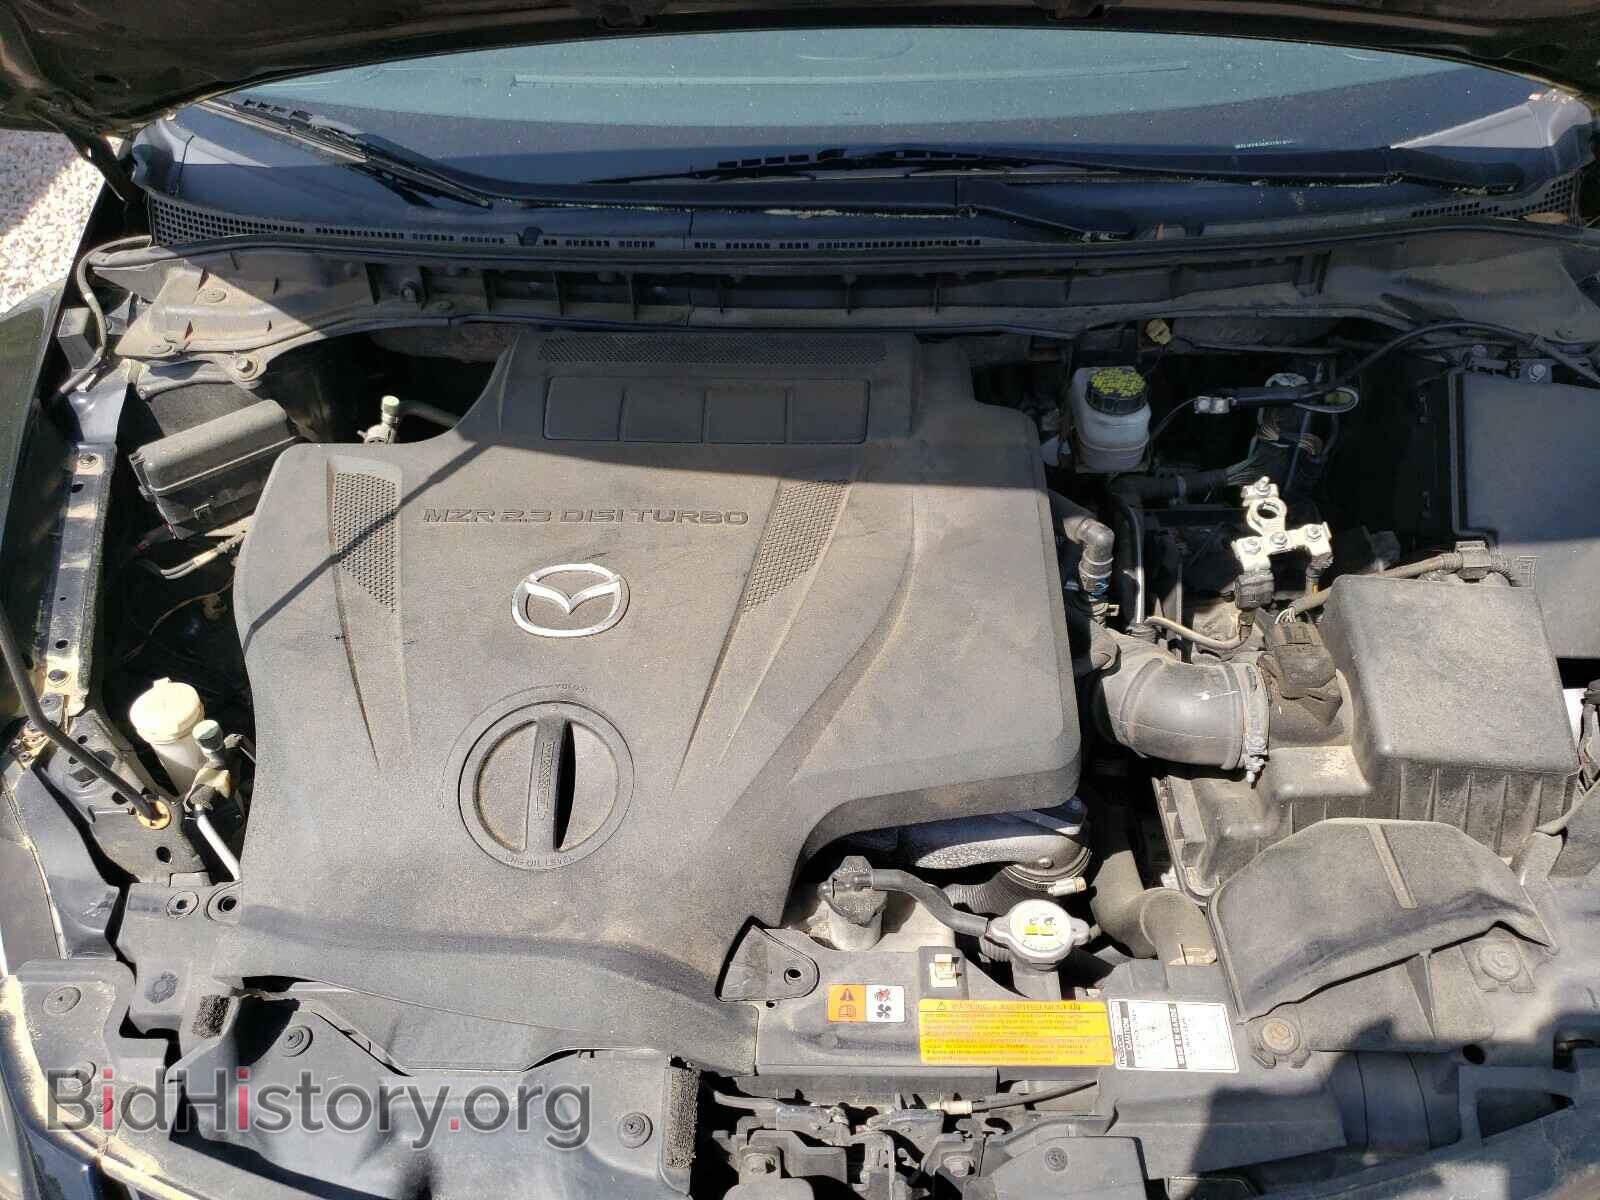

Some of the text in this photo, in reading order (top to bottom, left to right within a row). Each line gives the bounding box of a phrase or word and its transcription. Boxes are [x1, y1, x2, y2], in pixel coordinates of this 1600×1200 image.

[423, 508, 750, 526] MZR 2.3 DISI TURBO
